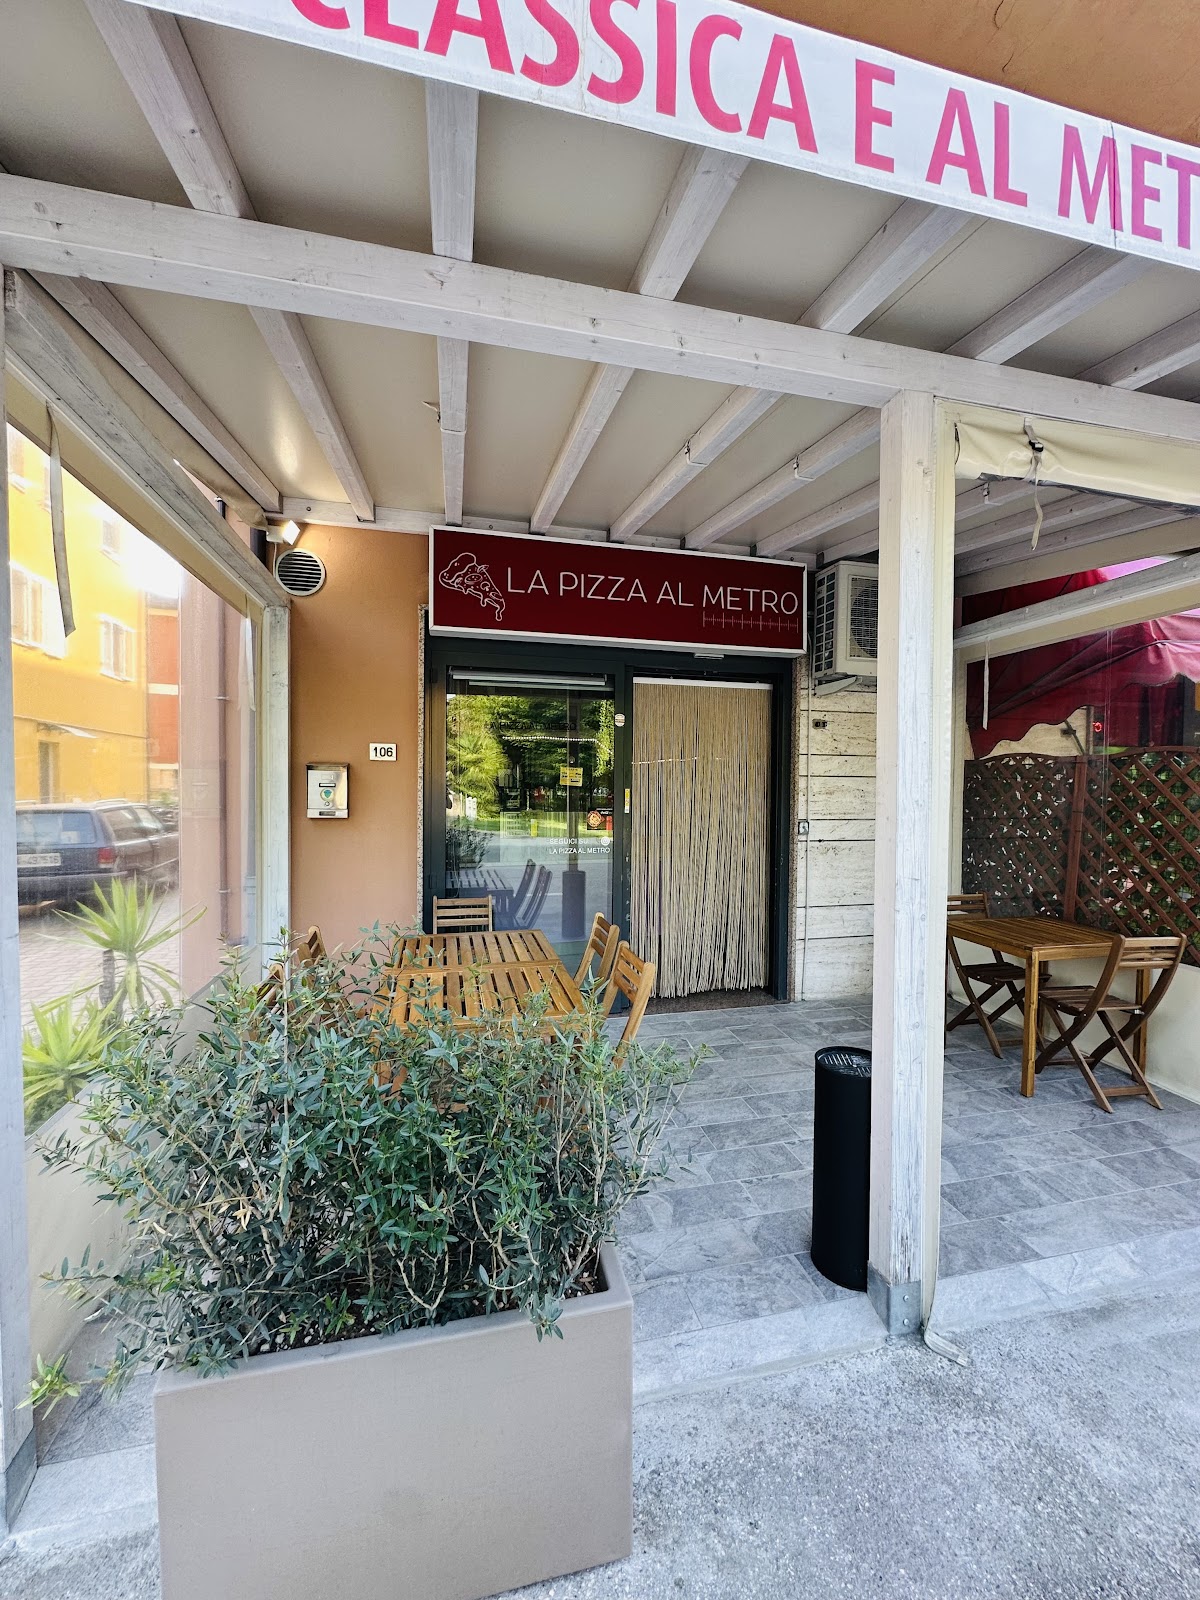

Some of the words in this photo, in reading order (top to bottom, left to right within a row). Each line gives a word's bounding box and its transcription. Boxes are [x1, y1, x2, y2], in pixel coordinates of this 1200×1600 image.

[855, 58, 895, 173] E
[925, 87, 1028, 208] AL
[1057, 123, 1200, 250] MET
[506, 567, 549, 596] LA
[559, 571, 647, 603] PIZZA
[656, 581, 694, 607] AL
[702, 585, 798, 615] METRO
[373, 746, 393, 758] 106
